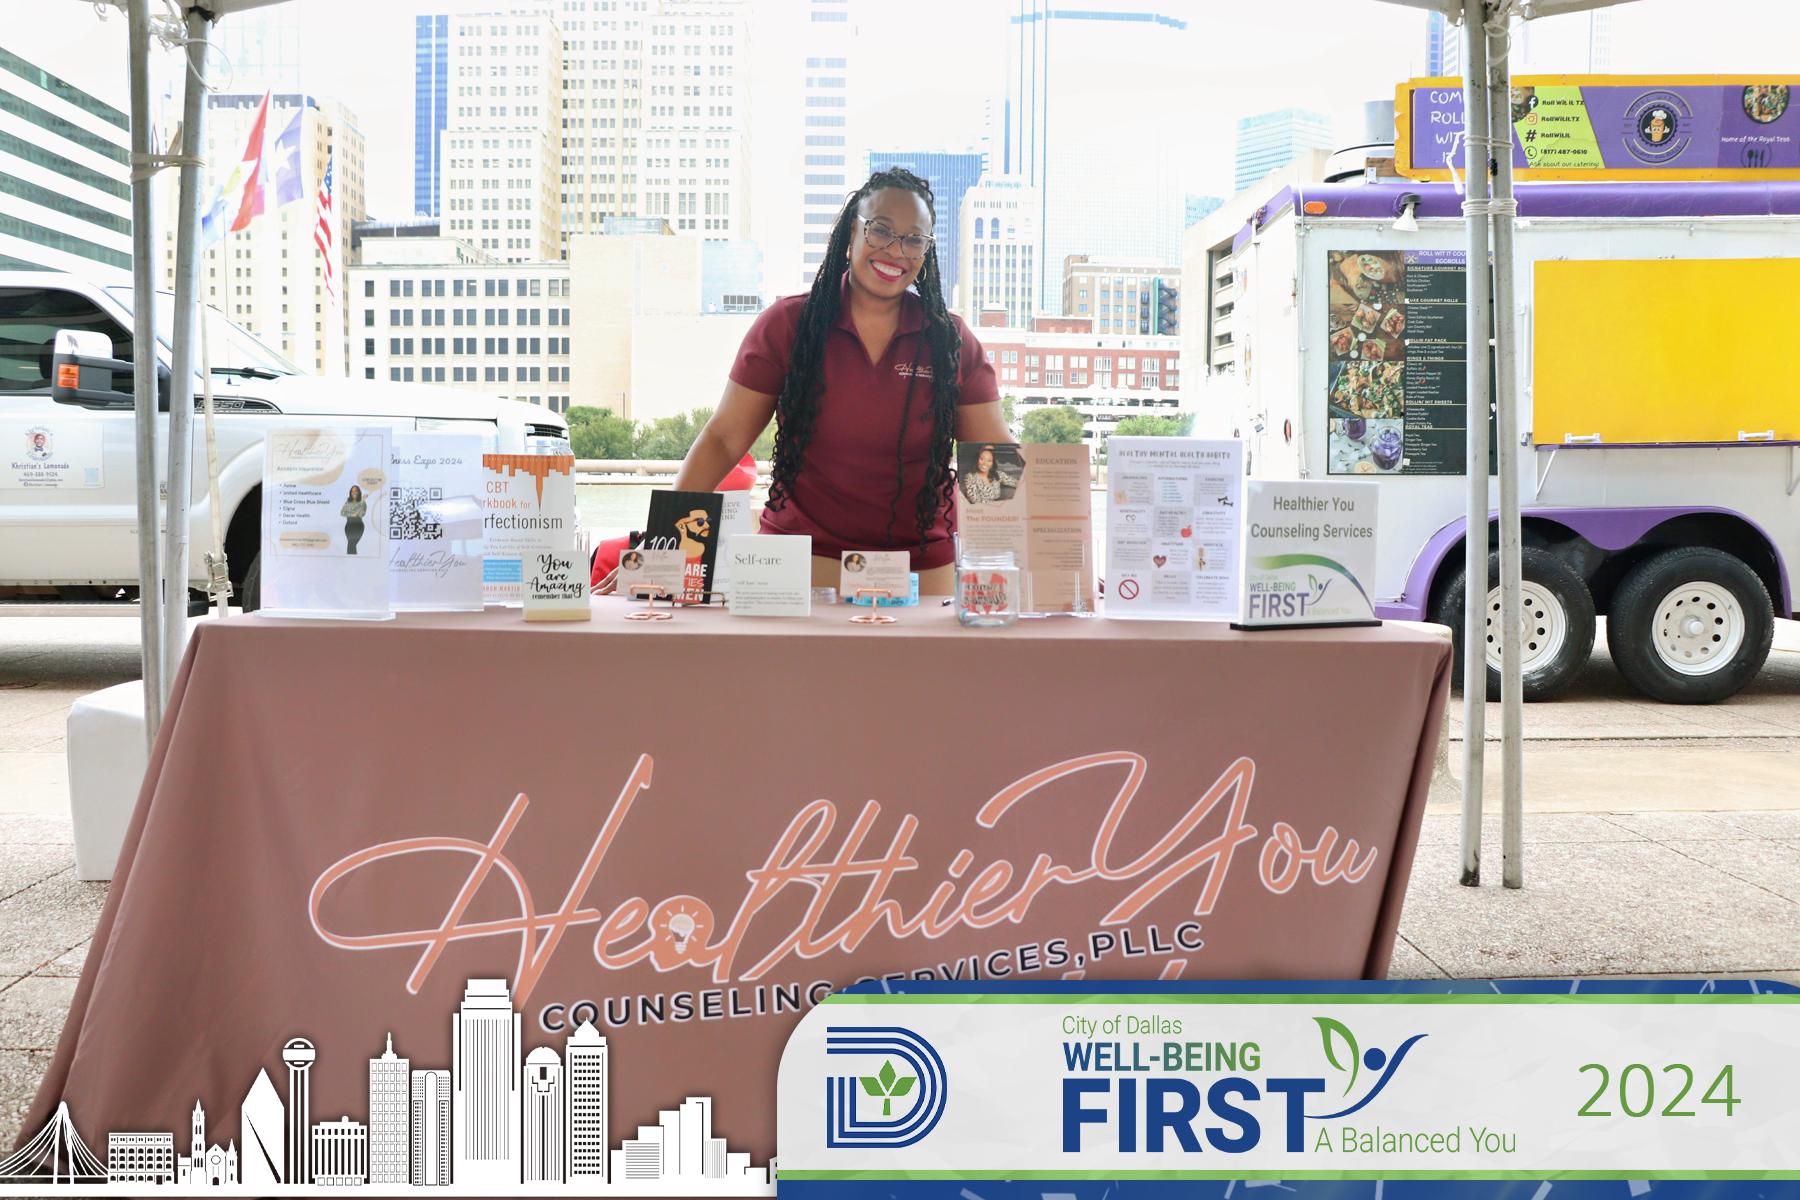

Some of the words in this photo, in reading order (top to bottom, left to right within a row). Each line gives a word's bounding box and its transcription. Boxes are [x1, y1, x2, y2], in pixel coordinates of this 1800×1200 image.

[1430, 91, 1463, 105] COM
[1721, 135, 1738, 143] Home
[1739, 135, 1746, 143] of
[1747, 135, 1757, 143] the
[1758, 135, 1775, 145] Royal
[390, 454, 411, 465] ness
[413, 455, 436, 469] Expo
[1149, 450, 1178, 458] MENTAL
[486, 481, 509, 493] CBT
[482, 498, 517, 509] rkbook
[520, 499, 531, 509] for
[1273, 496, 1329, 511] Healthier
[1331, 497, 1355, 512] You
[484, 513, 563, 529] rfectionism
[1251, 523, 1320, 542] Counseling
[1323, 523, 1374, 538] Services
[650, 535, 677, 550] 100
[537, 553, 572, 574] You
[734, 553, 783, 566] Self-care
[545, 573, 568, 582] are
[525, 577, 586, 599] Amazing
[1249, 582, 1296, 593] WELL-BEING
[561, 592, 573, 600] that
[1249, 592, 1310, 619] FIRST
[309, 752, 1108, 1009] Healthier
[976, 750, 1378, 926] You
[538, 980, 834, 1034] COUNSELING
